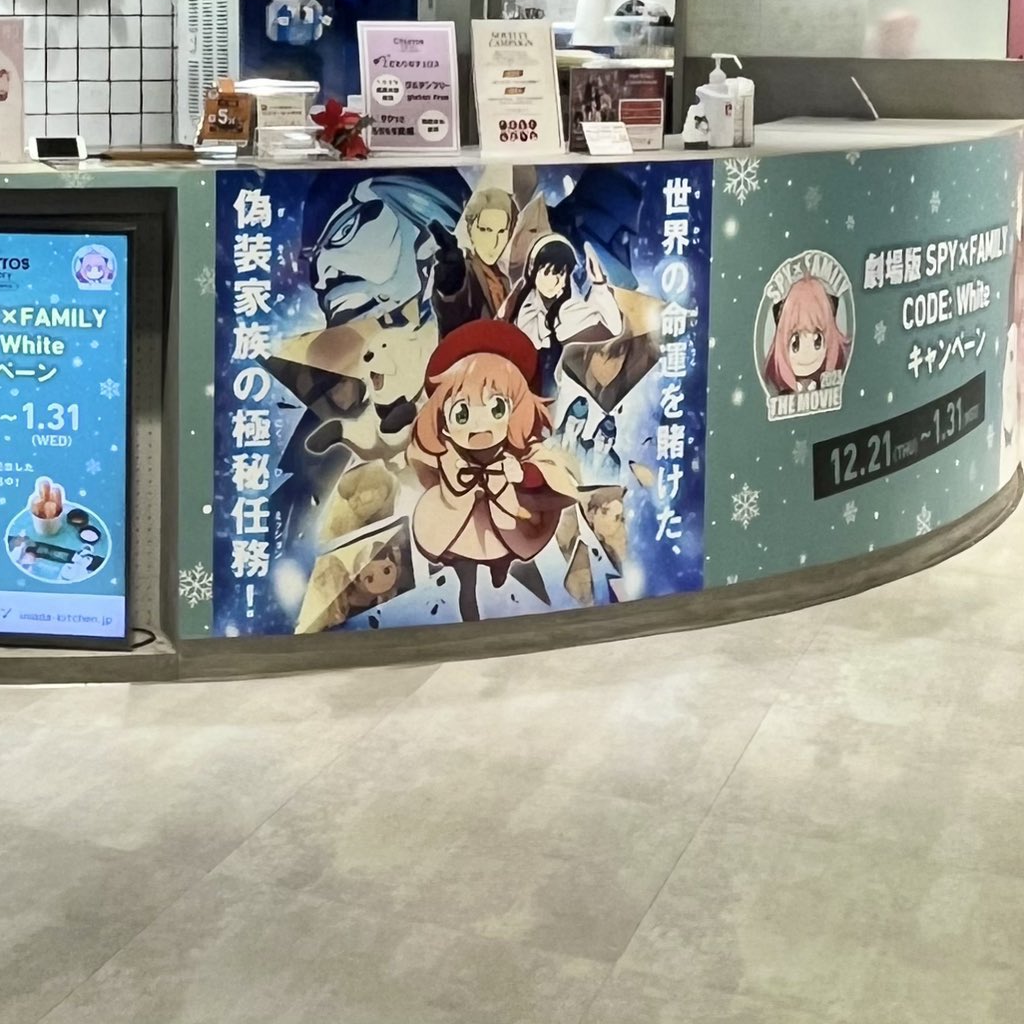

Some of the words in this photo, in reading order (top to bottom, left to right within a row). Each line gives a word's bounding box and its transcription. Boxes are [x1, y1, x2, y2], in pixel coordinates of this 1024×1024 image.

[863, 245, 922, 290] 劇場版
[902, 289, 953, 330] CODE:
[956, 279, 991, 316] White
[0, 334, 65, 355] White
[907, 328, 986, 379] キャンペーン
[769, 393, 796, 417] THE
[797, 386, 841, 414] MOVIE
